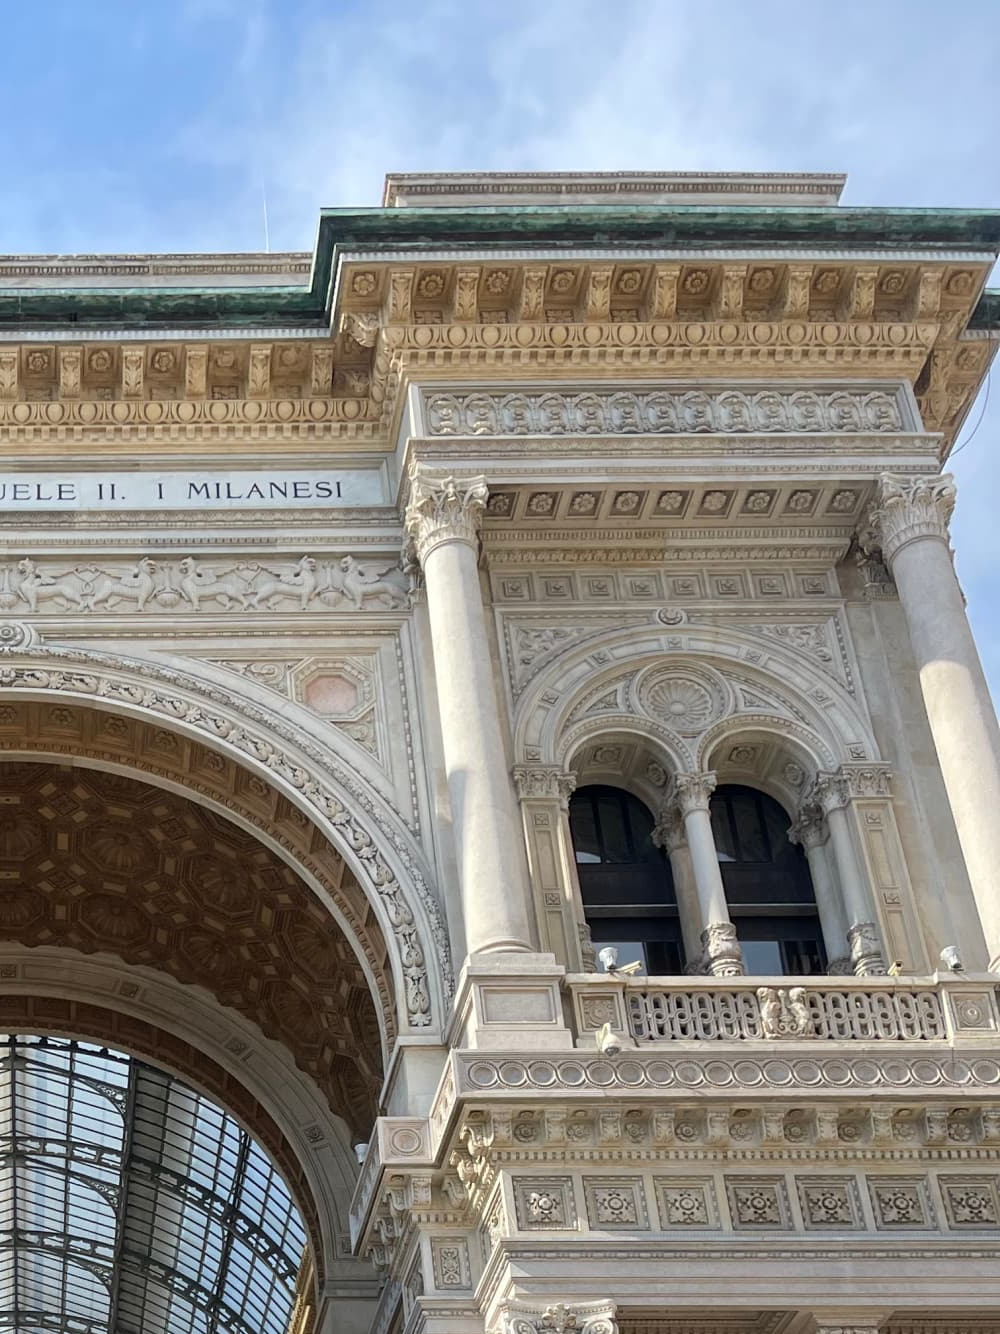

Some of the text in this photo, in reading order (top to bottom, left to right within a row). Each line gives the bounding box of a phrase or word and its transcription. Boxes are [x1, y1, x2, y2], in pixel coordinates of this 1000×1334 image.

[97, 484, 128, 501] II.
[157, 483, 165, 500] I
[187, 482, 344, 500] MILANESI
